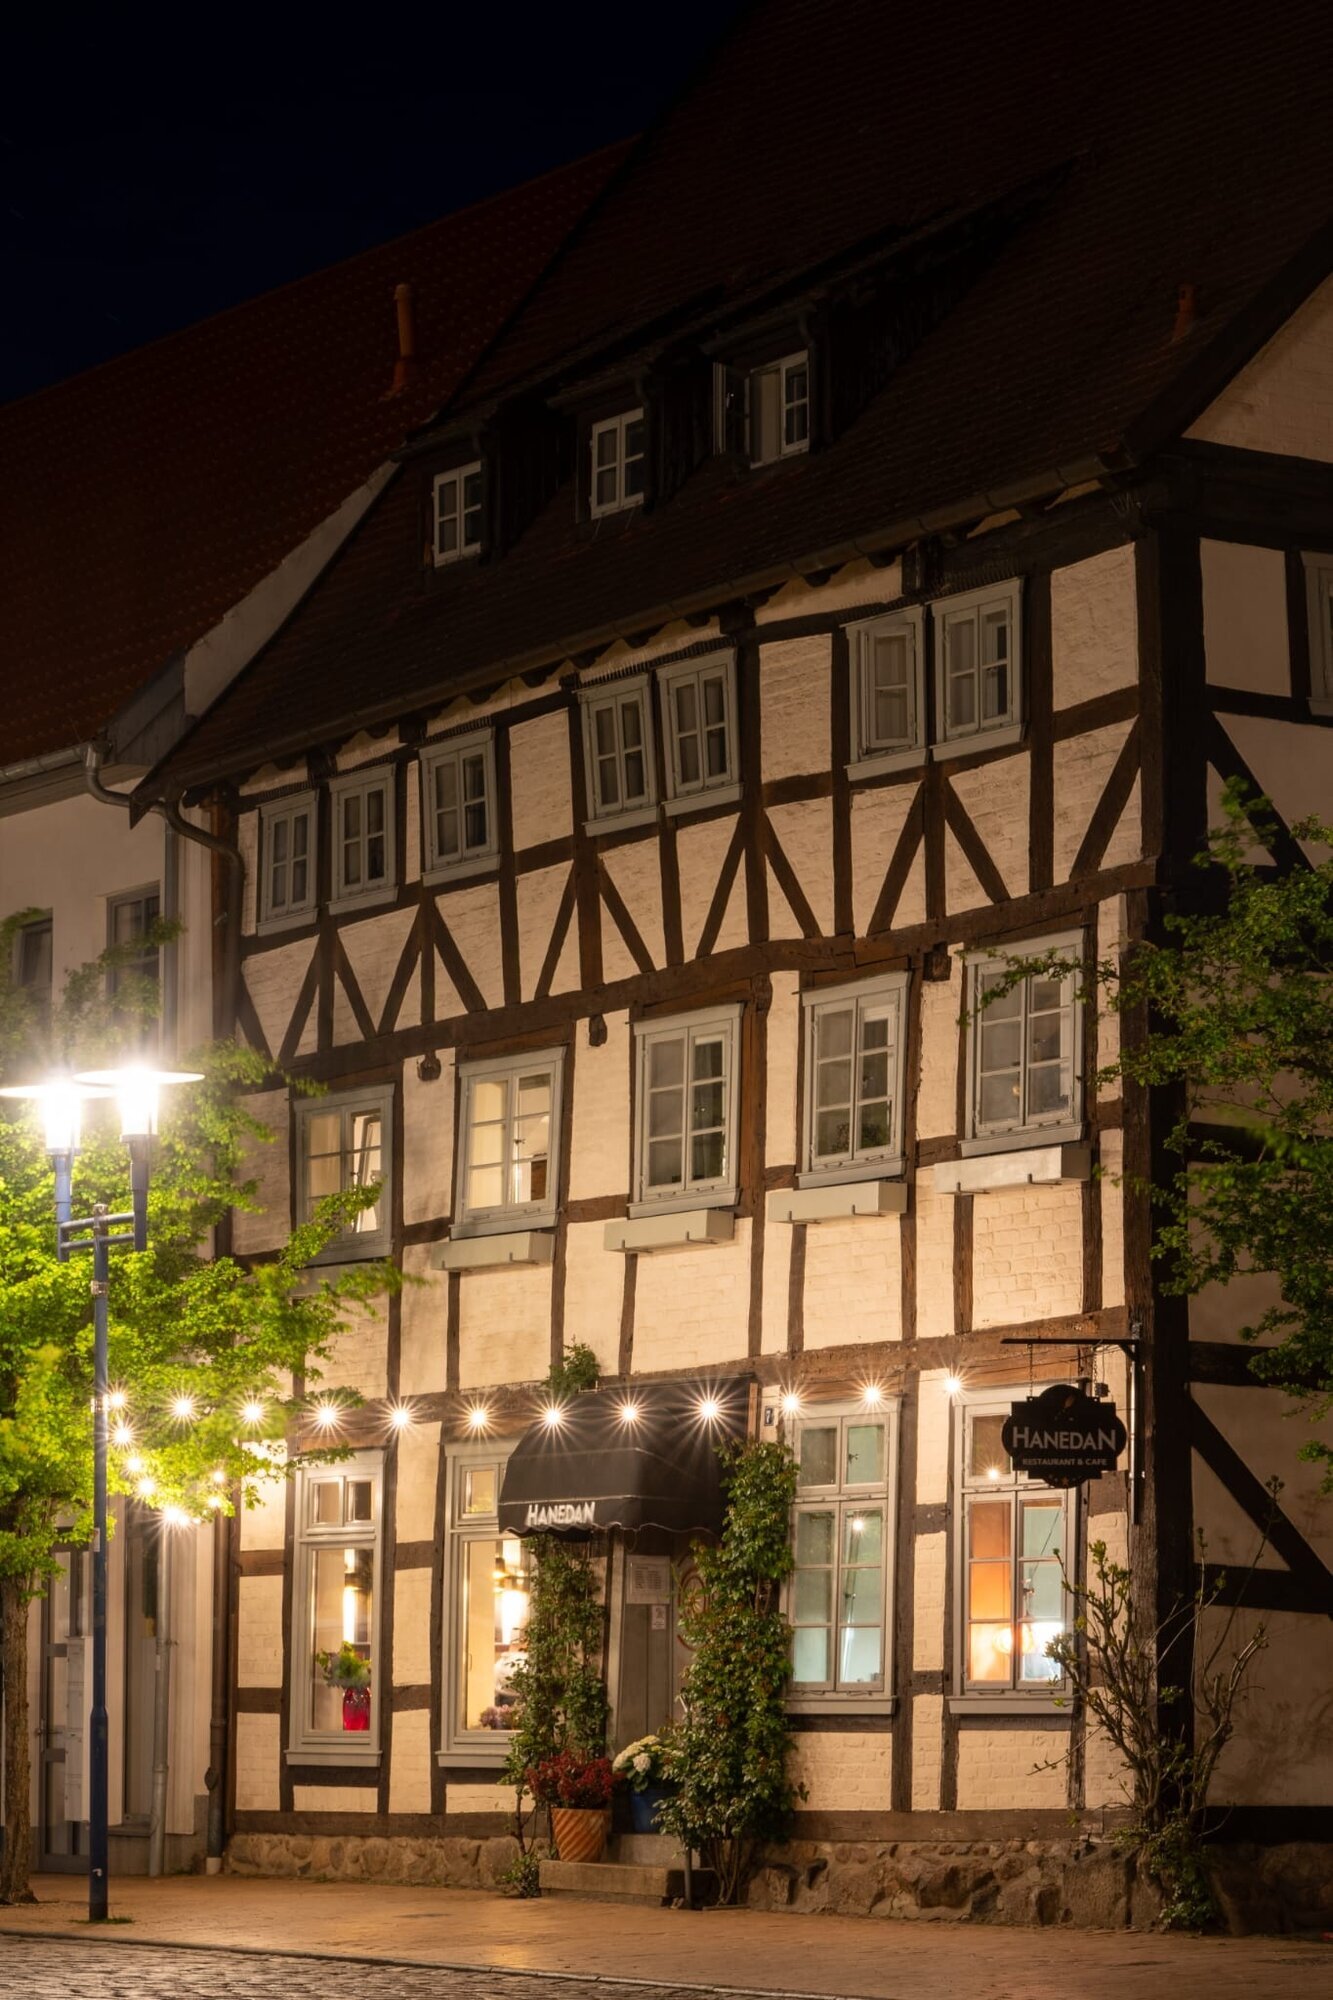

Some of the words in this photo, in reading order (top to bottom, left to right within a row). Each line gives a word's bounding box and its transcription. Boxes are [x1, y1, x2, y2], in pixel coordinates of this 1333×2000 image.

[1012, 1426, 1116, 1451] HANEDAN
[1022, 1458, 1075, 1466] RESTAURANT
[1077, 1458, 1083, 1466] &
[525, 1501, 596, 1527] HANEDAN
